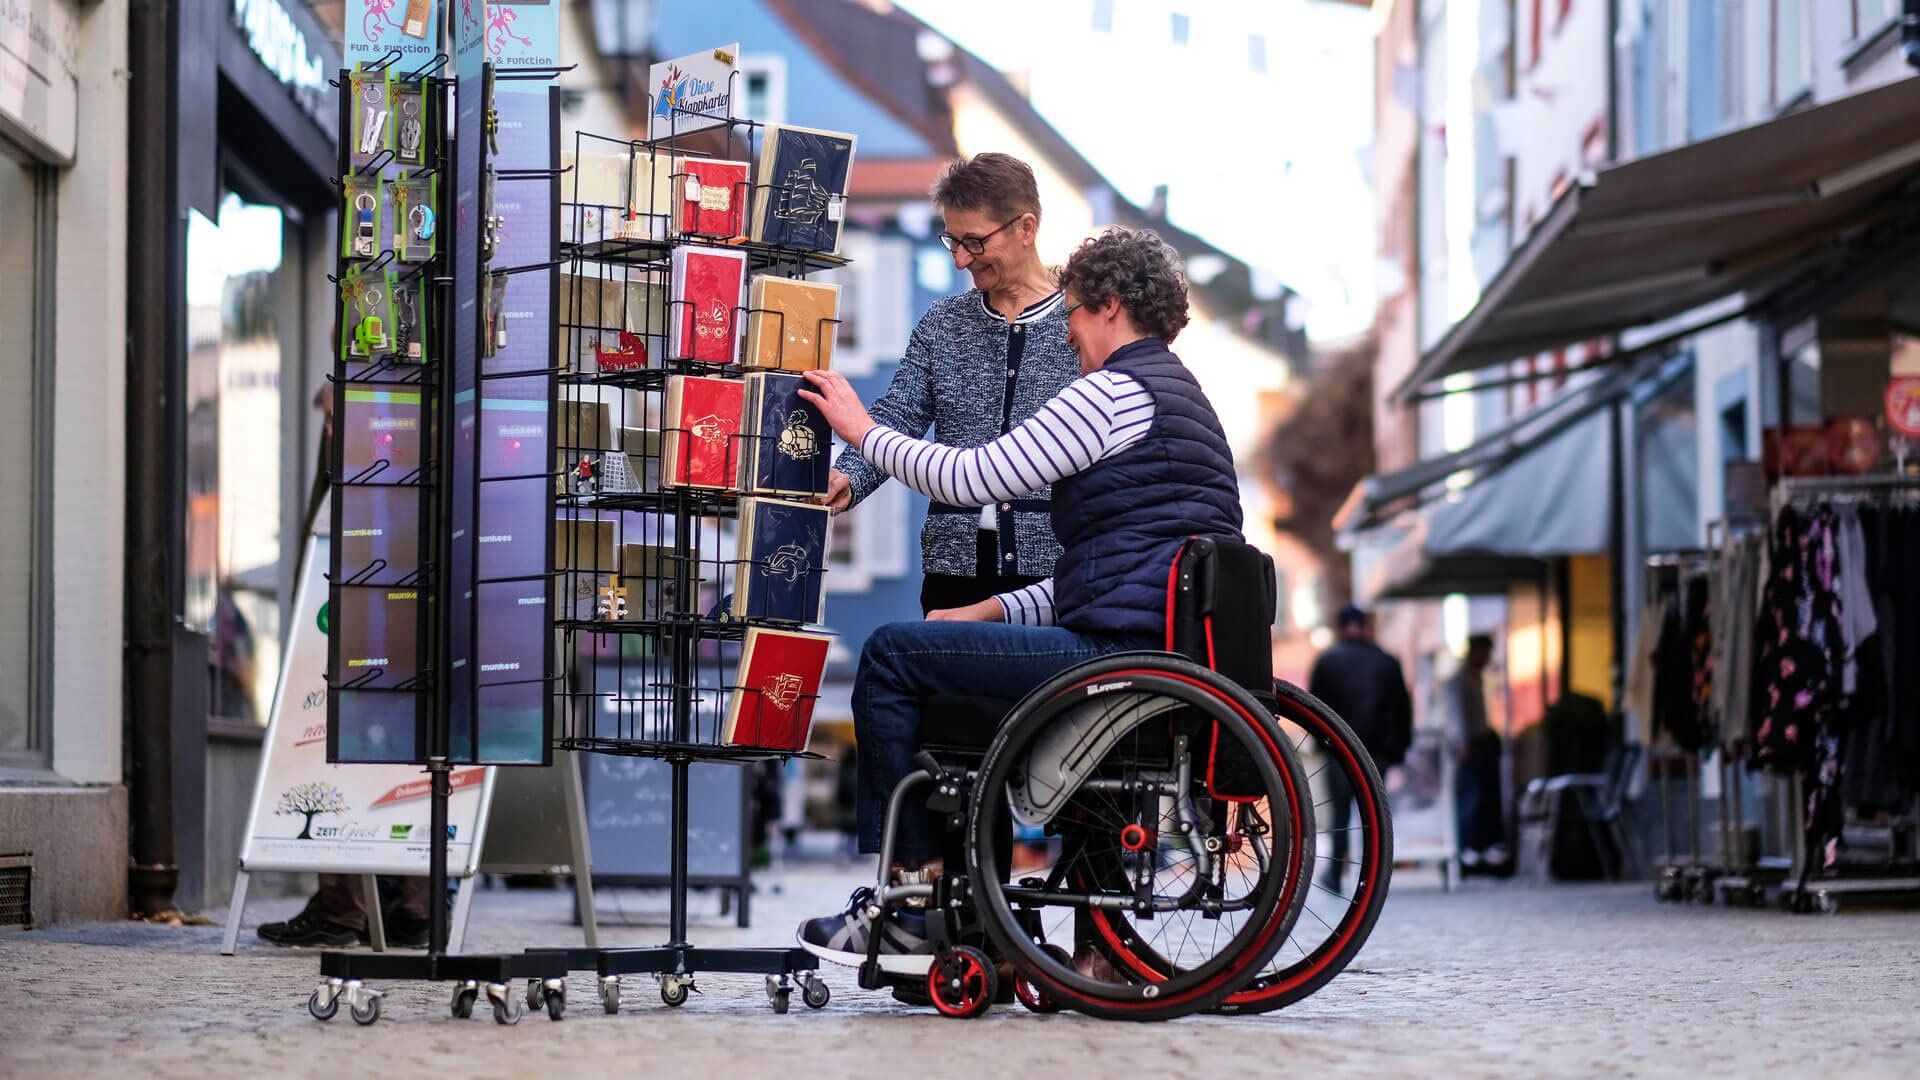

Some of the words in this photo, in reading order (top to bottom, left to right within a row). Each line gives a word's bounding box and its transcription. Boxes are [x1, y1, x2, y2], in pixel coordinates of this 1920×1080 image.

[373, 44, 381, 53] &
[496, 56, 504, 65] &
[689, 78, 715, 97] Diese
[343, 529, 383, 537] munkees
[349, 658, 389, 667] munkees
[481, 662, 520, 672] munkees
[316, 826, 338, 837] ZEIT
